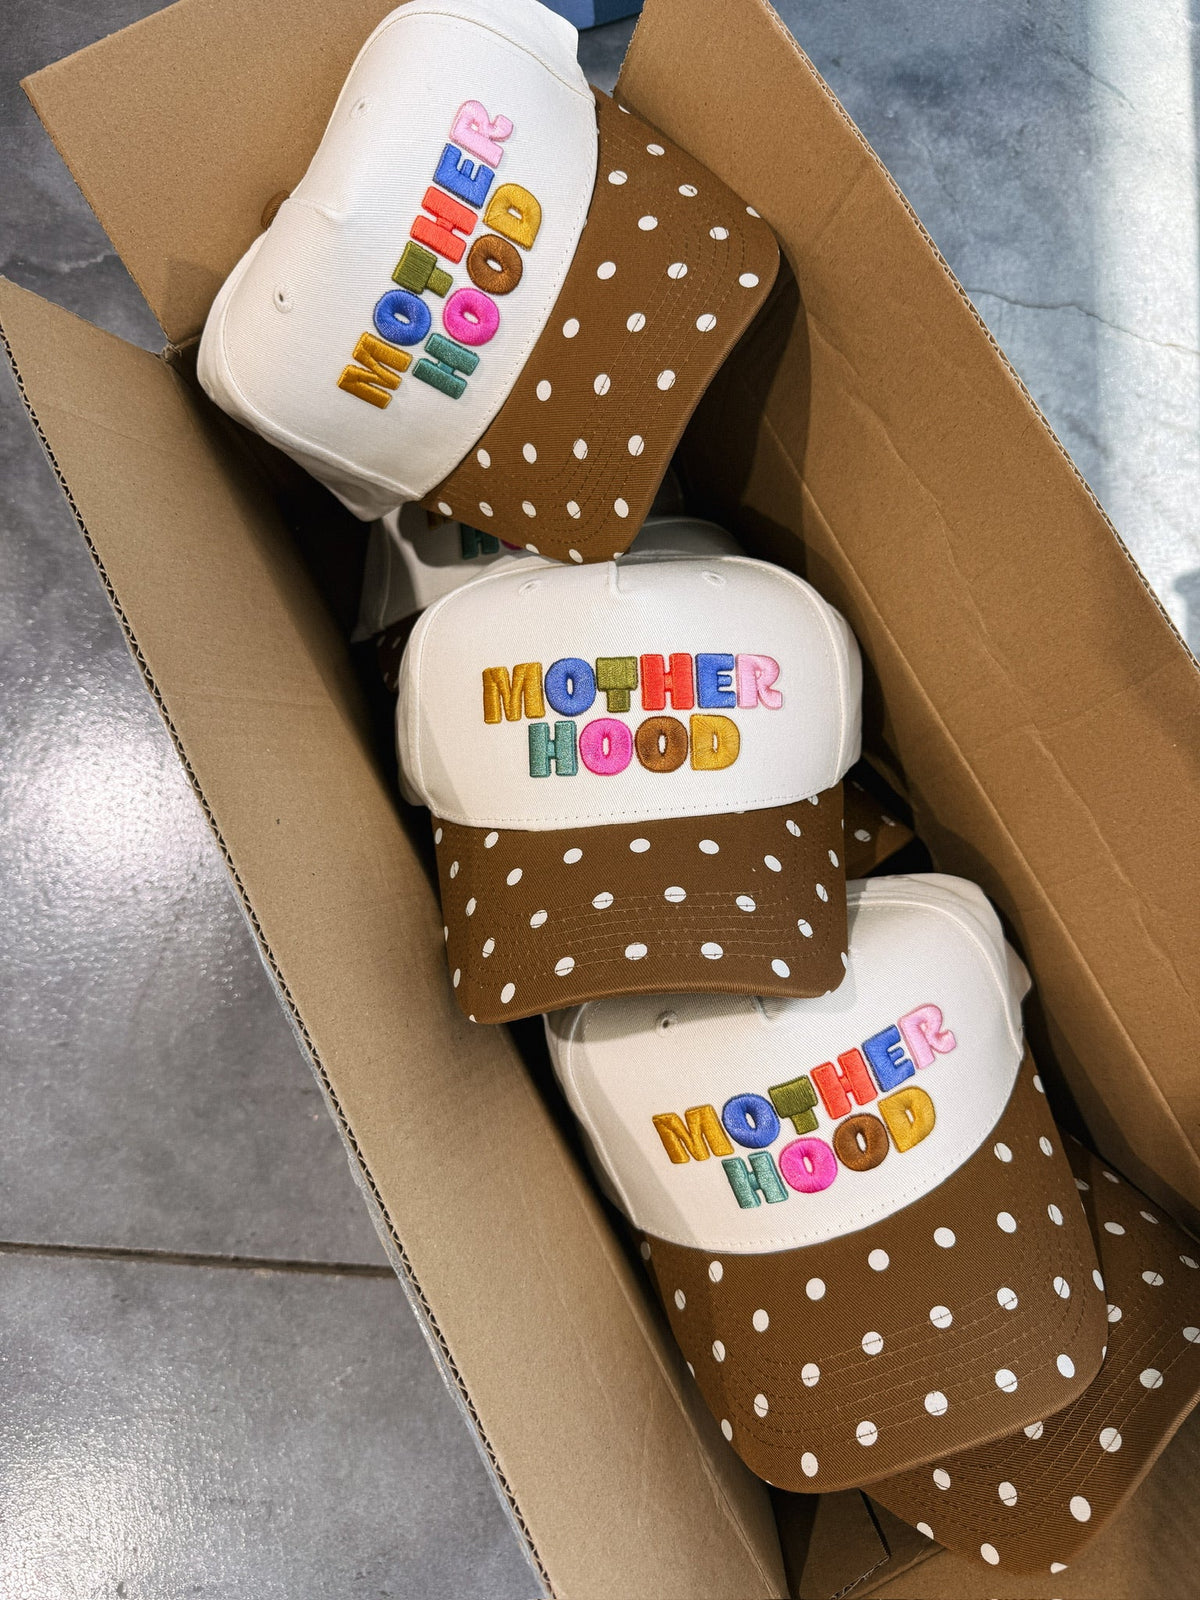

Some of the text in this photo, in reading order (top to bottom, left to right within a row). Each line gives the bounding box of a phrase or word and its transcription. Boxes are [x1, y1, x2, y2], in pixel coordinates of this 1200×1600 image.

[337, 99, 514, 409] MOTHER
[412, 182, 542, 399] HOOD
[482, 653, 783, 724] MOTHER
[528, 713, 741, 778] HOOD
[652, 1003, 957, 1164] MOTHER
[721, 1085, 936, 1209] HOOD
